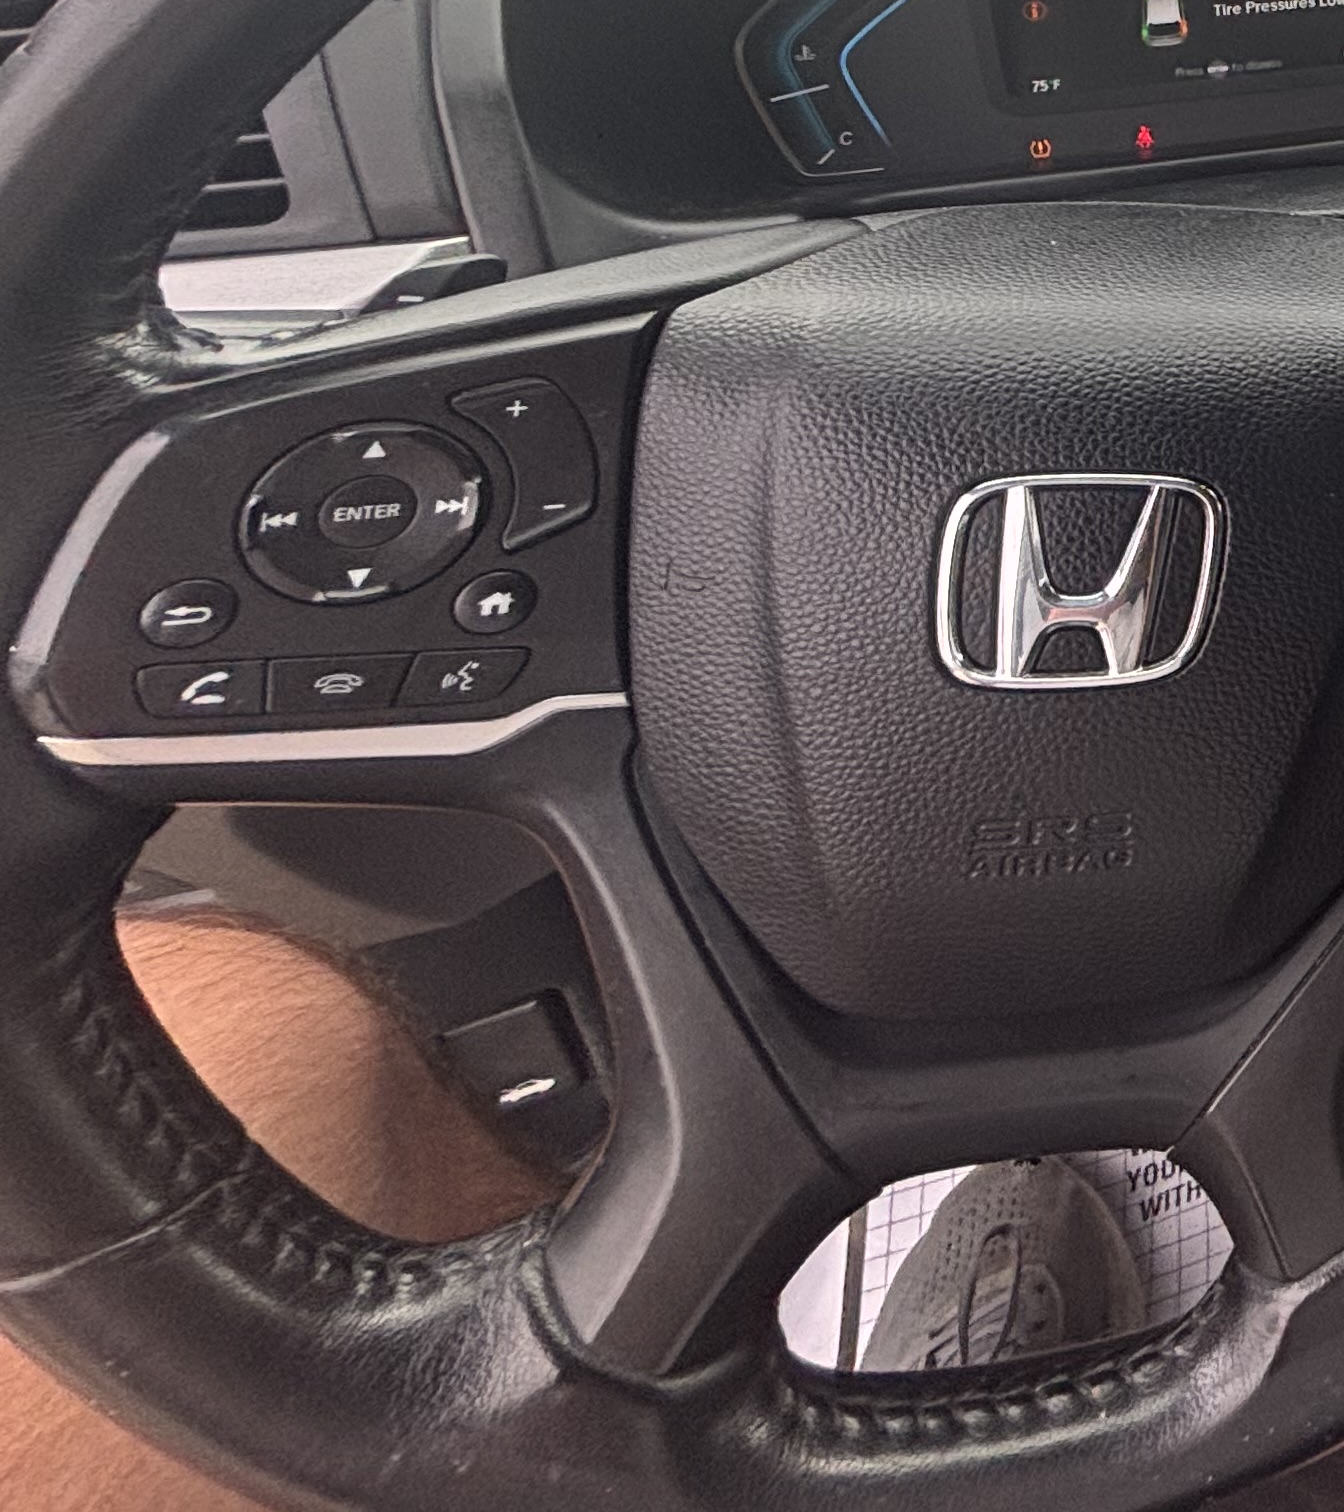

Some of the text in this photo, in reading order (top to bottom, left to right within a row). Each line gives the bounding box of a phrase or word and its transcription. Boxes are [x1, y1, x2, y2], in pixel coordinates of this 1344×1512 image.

[1213, 1, 1242, 18] Tire
[839, 131, 853, 146] C
[333, 502, 401, 523] ENTER
[1140, 1181, 1202, 1222] WITH
